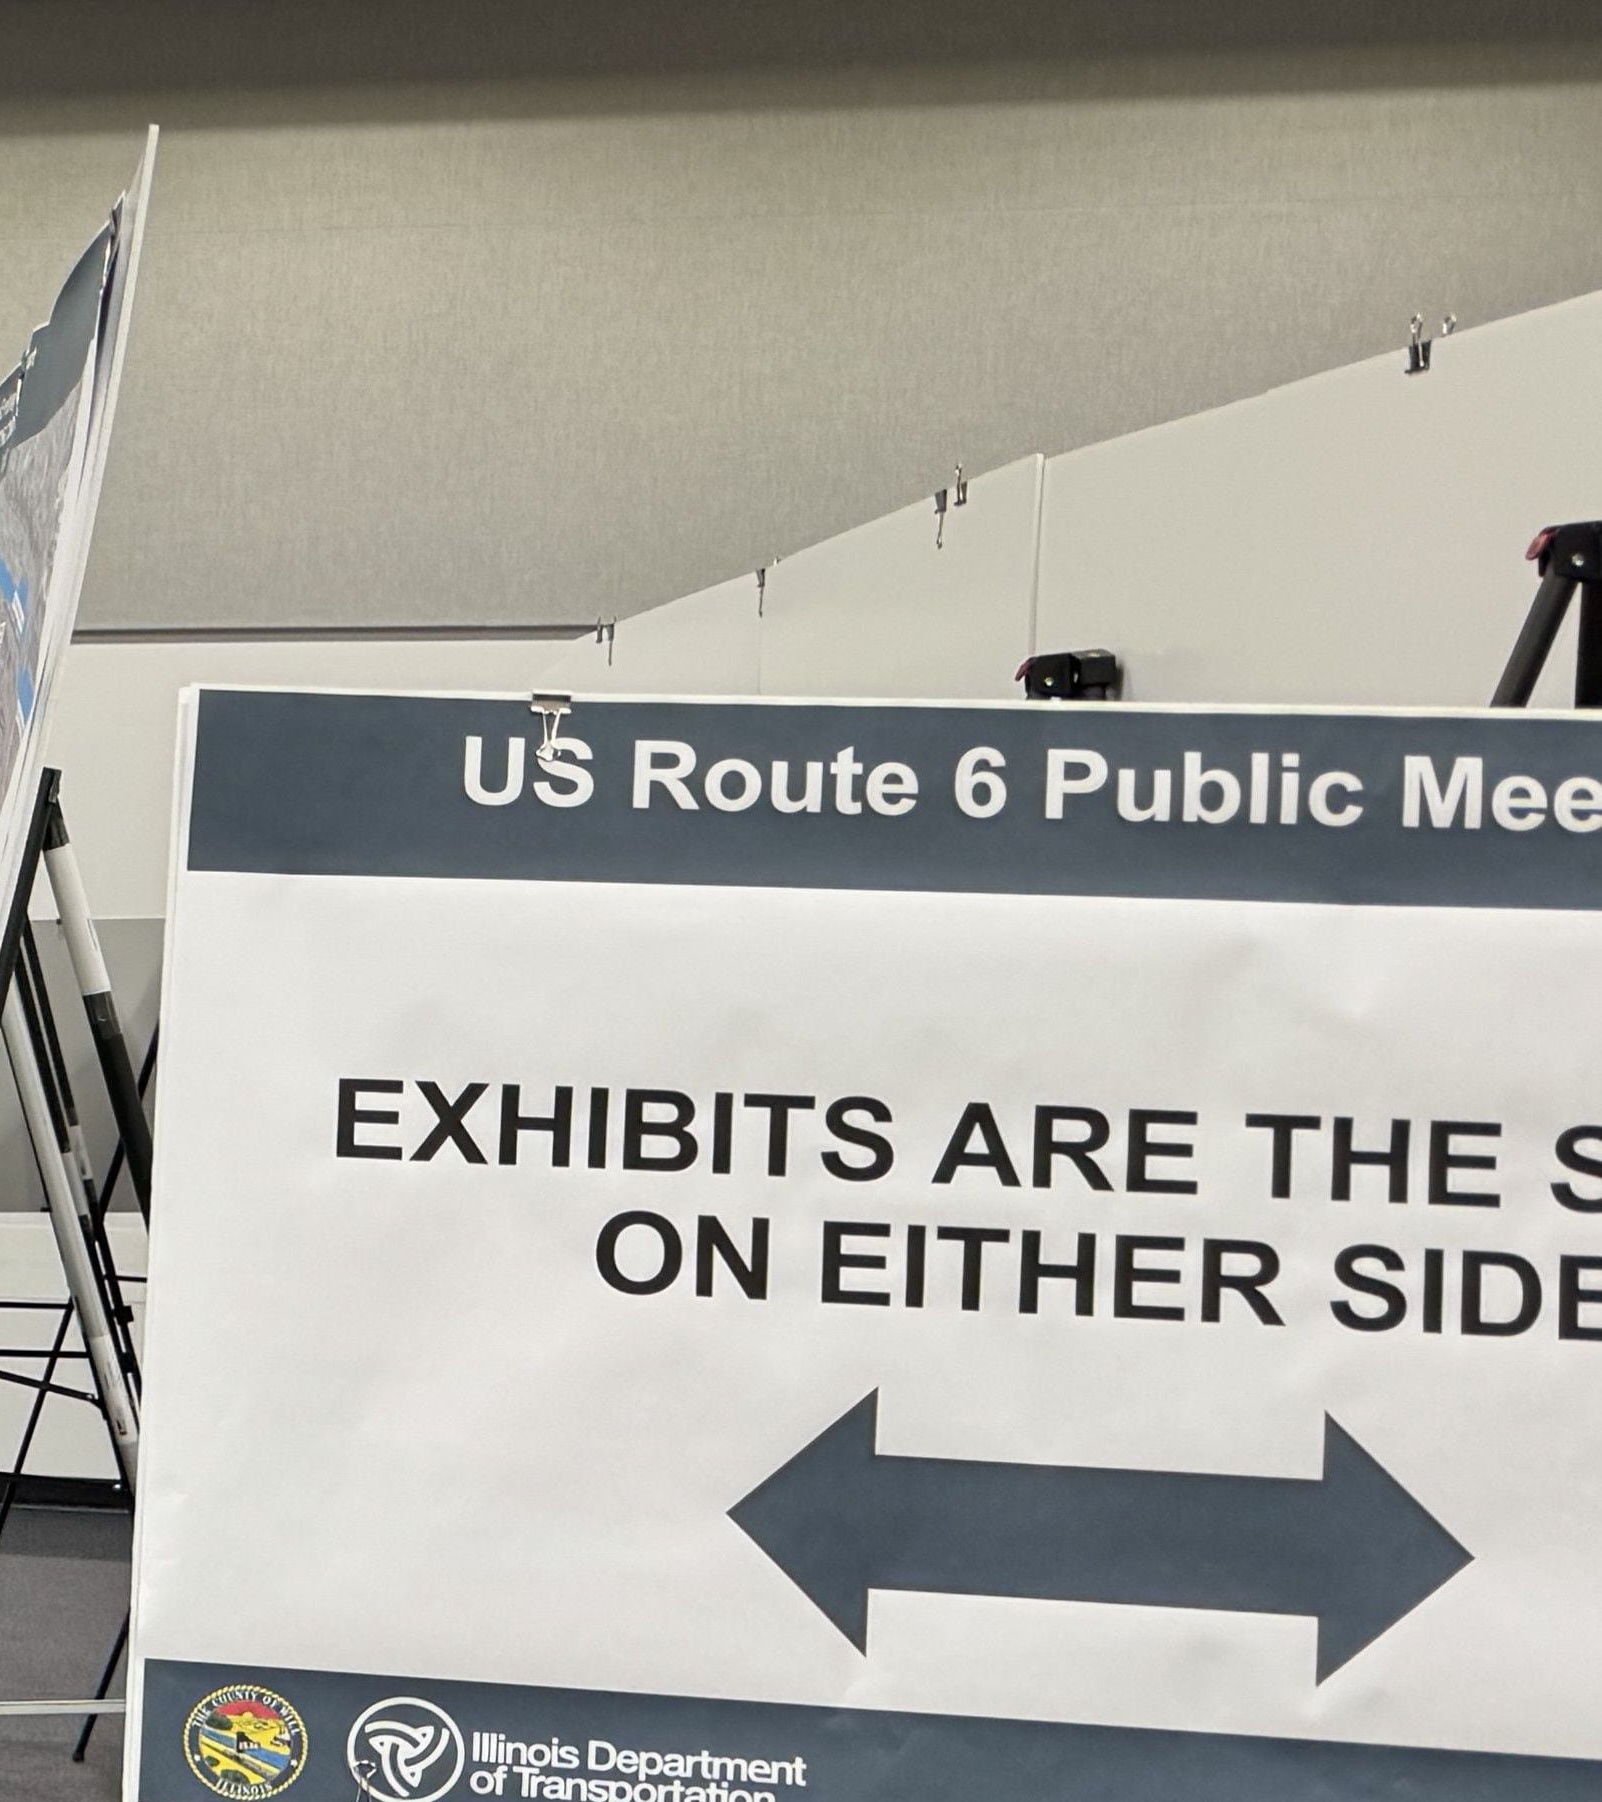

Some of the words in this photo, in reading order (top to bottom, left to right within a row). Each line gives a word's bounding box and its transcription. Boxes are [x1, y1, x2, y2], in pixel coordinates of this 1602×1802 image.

[462, 735, 595, 808] US
[631, 739, 920, 817] Route
[953, 746, 1007, 819] 6
[1044, 748, 1365, 827] Public
[336, 1077, 895, 1183] EXHIBITS
[931, 1102, 1198, 1196] ARE
[1244, 1112, 1502, 1209] THE
[595, 1210, 770, 1301] ON
[821, 1220, 1287, 1327] EITHER
[192, 1706, 211, 1727] THE
[211, 1689, 259, 1707] COUNTY
[262, 1695, 280, 1708] OF
[280, 1707, 300, 1736] WILL
[469, 1766, 507, 1797] of
[471, 1731, 581, 1770] Illinois
[587, 1739, 807, 1788] Department
